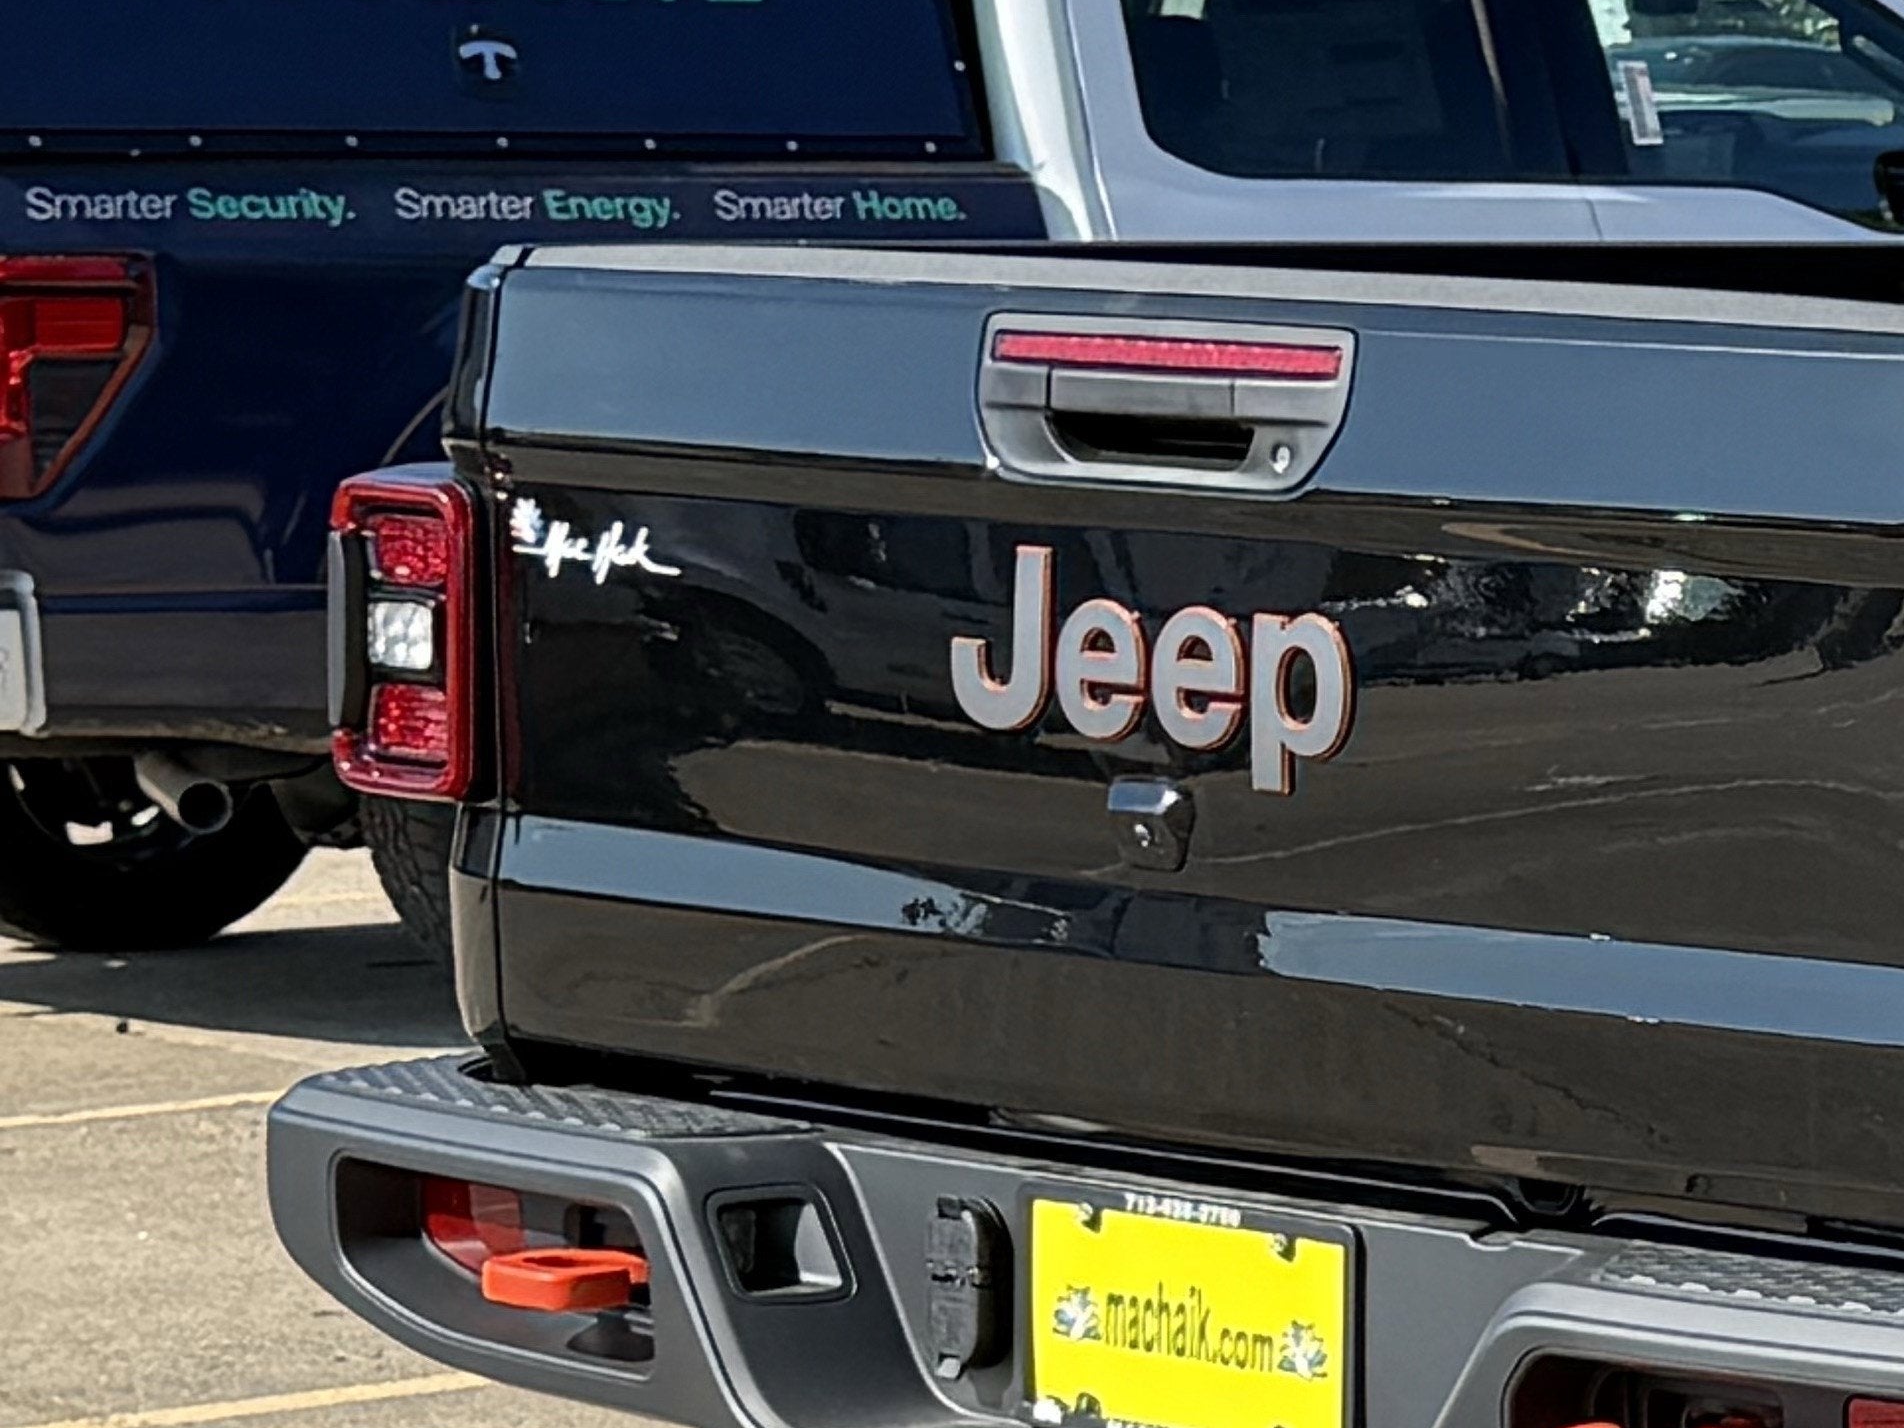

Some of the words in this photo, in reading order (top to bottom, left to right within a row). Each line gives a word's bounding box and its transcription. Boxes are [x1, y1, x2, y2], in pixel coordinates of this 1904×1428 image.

[25, 186, 178, 221] Smarter
[187, 187, 356, 227] Security.
[394, 187, 533, 221] Smarter
[542, 188, 681, 228] Energy.
[713, 189, 845, 221] Smarter
[852, 190, 967, 221] Home.
[951, 545, 1358, 796] Jeep
[1104, 1280, 1275, 1373] machaik.com
